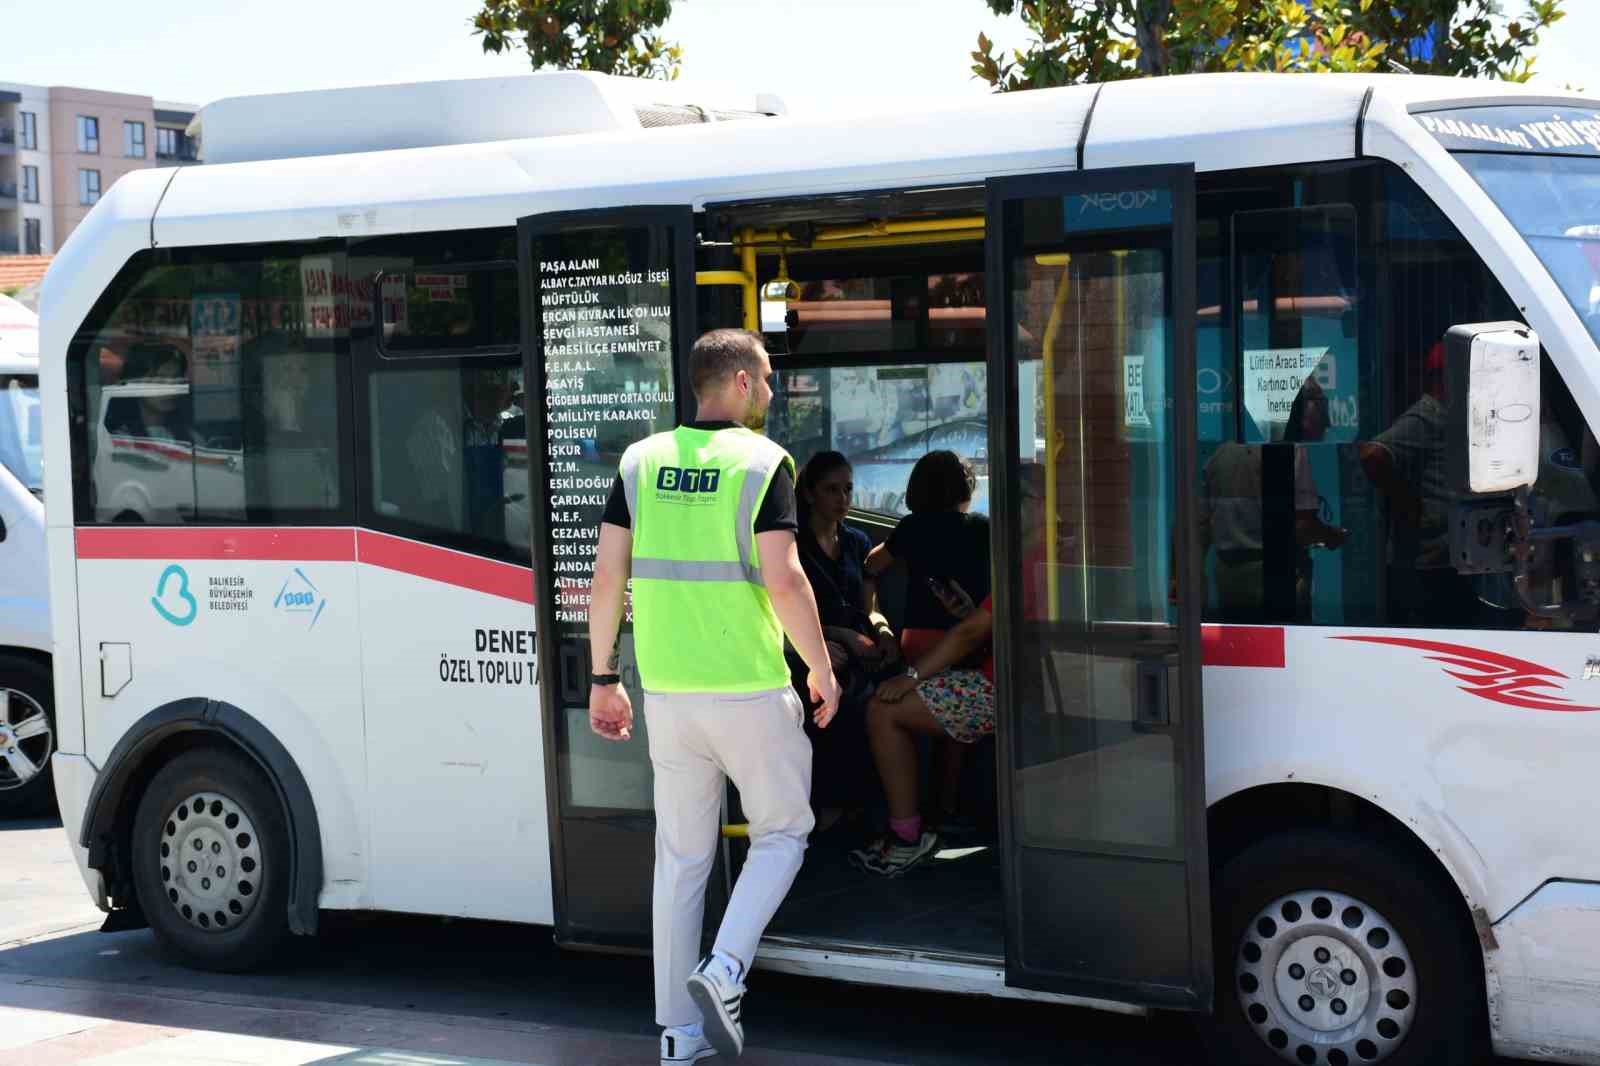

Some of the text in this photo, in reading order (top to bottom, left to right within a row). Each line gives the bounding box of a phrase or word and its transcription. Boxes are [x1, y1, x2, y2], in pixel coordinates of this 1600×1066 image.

[1520, 114, 1584, 149] YENİ
[540, 258, 599, 275] PAŞA ALANI
[541, 277, 568, 289] ALBAY
[568, 274, 608, 288] C.TAYYAR
[646, 268, 669, 283] İSESİ
[541, 291, 600, 306] MÜFTÜLÜK
[543, 310, 576, 323] ERCAN
[577, 308, 616, 322] KIVRAK
[617, 305, 633, 319] İLK
[543, 324, 640, 340] SEVGİ HASTANESİ
[544, 340, 661, 357] KARESİ İLÇE EMNİYET
[1275, 354, 1297, 370] Araca
[545, 377, 584, 391] ASAYİŞ
[546, 390, 675, 409] ÇİĞDEM BATUBEY ORTA OKULU
[547, 408, 657, 423] K.MİLLİYE KARAKOL
[547, 424, 597, 439] POLİSEVİ
[548, 443, 581, 457] İŞKUR
[549, 462, 580, 473] T.T.M.
[550, 475, 575, 489] ESKİ
[661, 468, 718, 492] BTT
[550, 494, 606, 509] ÇARDAKLI
[551, 512, 582, 522] N.E.F.
[552, 526, 599, 539] CEZAEVİ
[552, 542, 599, 556] ESKİ SSK
[208, 576, 245, 586] BALIKESİR
[209, 588, 253, 601] BÜYÜKŞEHİR
[209, 600, 248, 611] BELEDİYESİ
[555, 608, 588, 622] FAHRİ
[439, 653, 475, 683] ÖZEL
[477, 660, 523, 685] TOPLU
